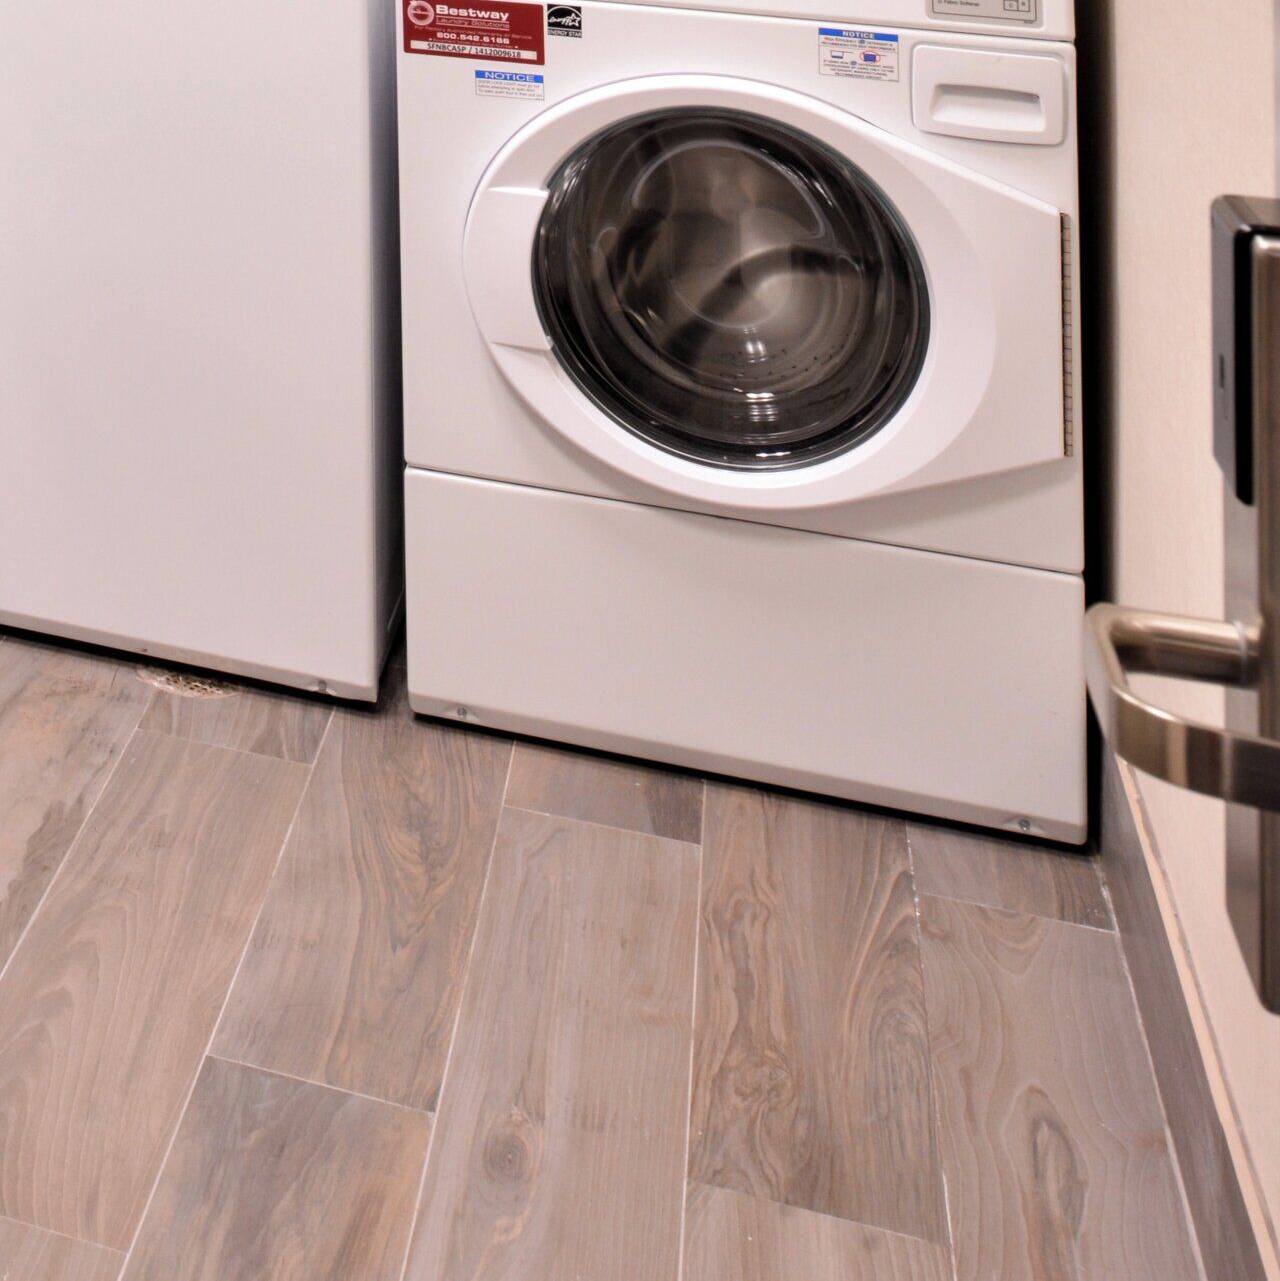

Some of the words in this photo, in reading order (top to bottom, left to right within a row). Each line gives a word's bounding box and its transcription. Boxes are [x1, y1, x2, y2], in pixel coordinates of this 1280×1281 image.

[436, 4, 509, 21] Bestway
[436, 18, 469, 27] Laundry
[471, 19, 510, 28] Solutions
[842, 31, 875, 39] NOTICE
[427, 42, 466, 53] SFNBCASP
[475, 47, 521, 58] 1412009618
[485, 71, 534, 82] NOTICE
